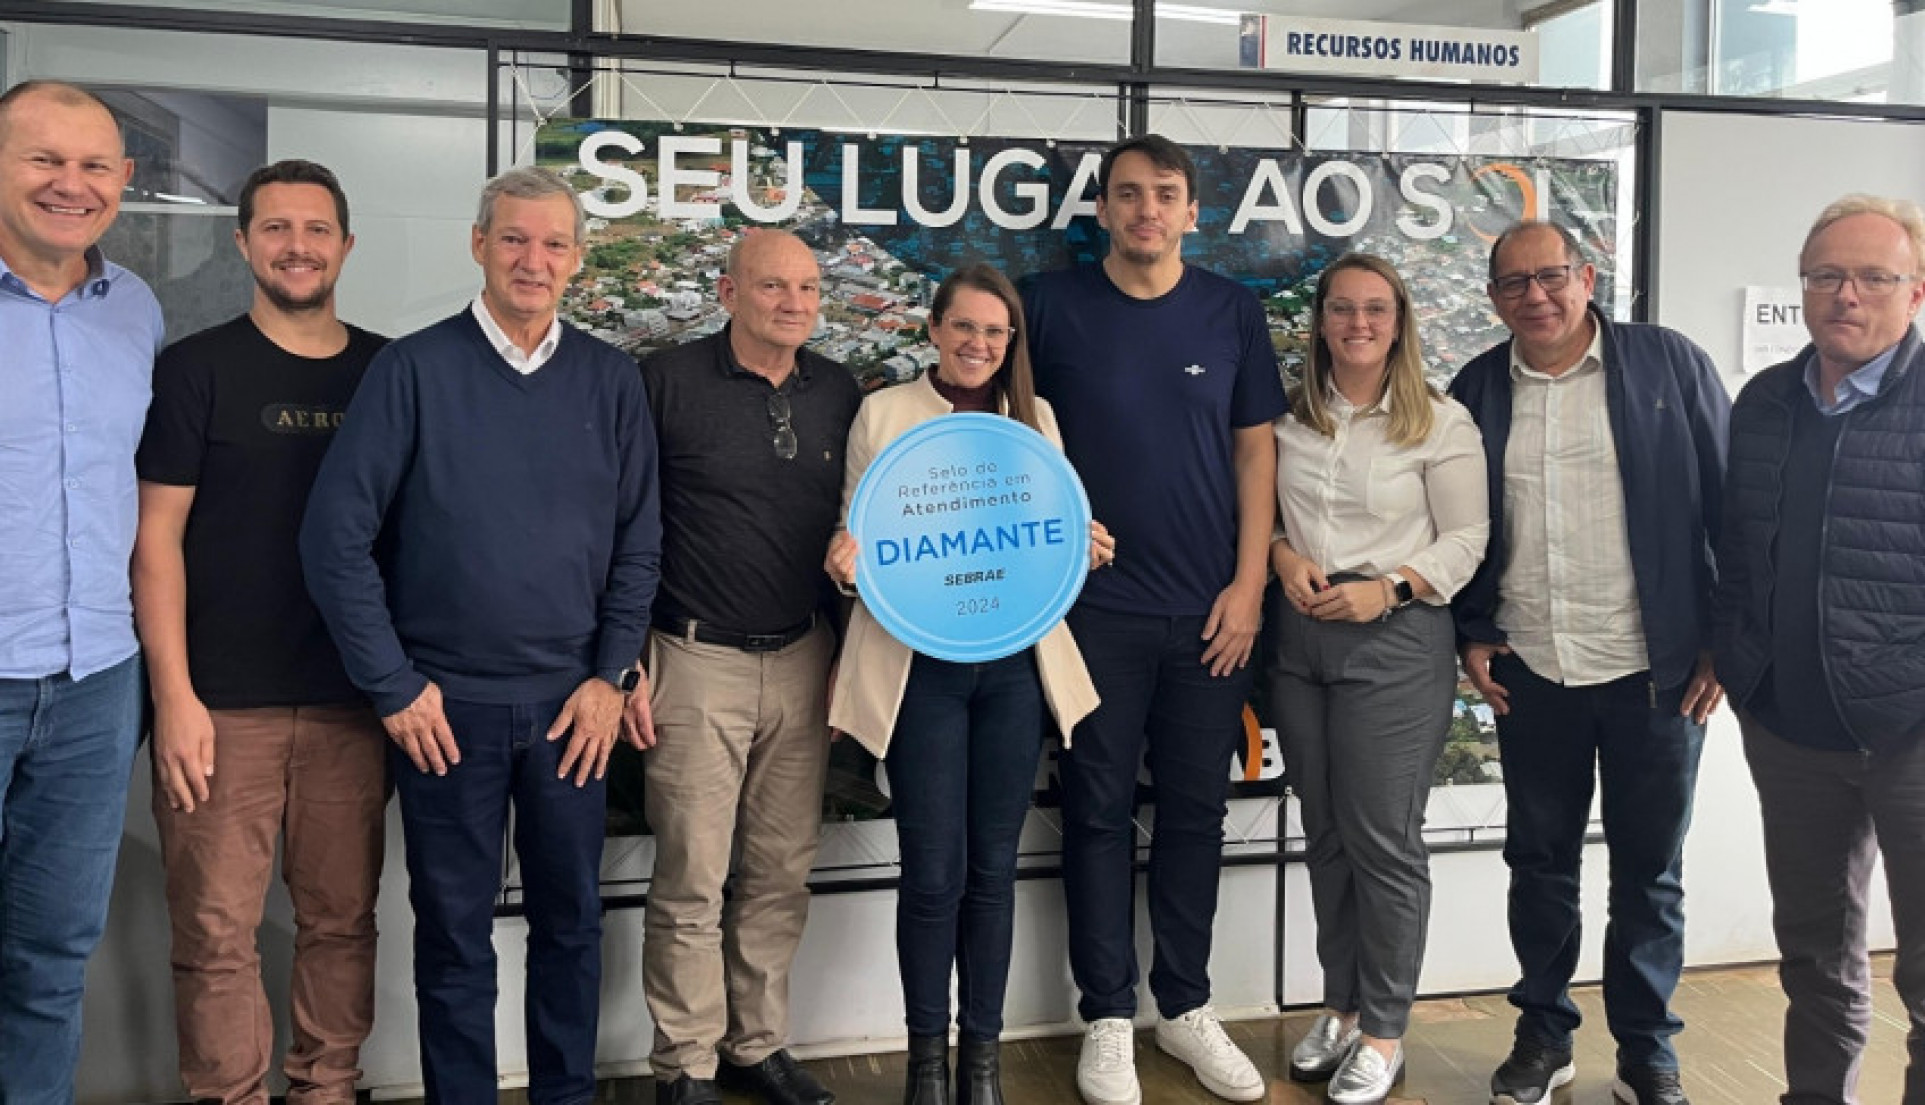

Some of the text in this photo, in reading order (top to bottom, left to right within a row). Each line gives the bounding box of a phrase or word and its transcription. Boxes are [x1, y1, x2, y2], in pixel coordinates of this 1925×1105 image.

[1287, 31, 1520, 66] RECURSOS HUMANOS
[578, 130, 802, 224] SEU
[841, 142, 1199, 232] LUGA
[1228, 158, 1372, 237] AO
[1756, 303, 1801, 325] ENT
[928, 464, 968, 480] Selo
[898, 473, 1031, 498] Referência em
[902, 491, 1032, 516] Atendimento
[876, 519, 1065, 566] DIAMANTE
[944, 568, 1006, 586] SEBRAE
[956, 596, 1000, 616] 2024
